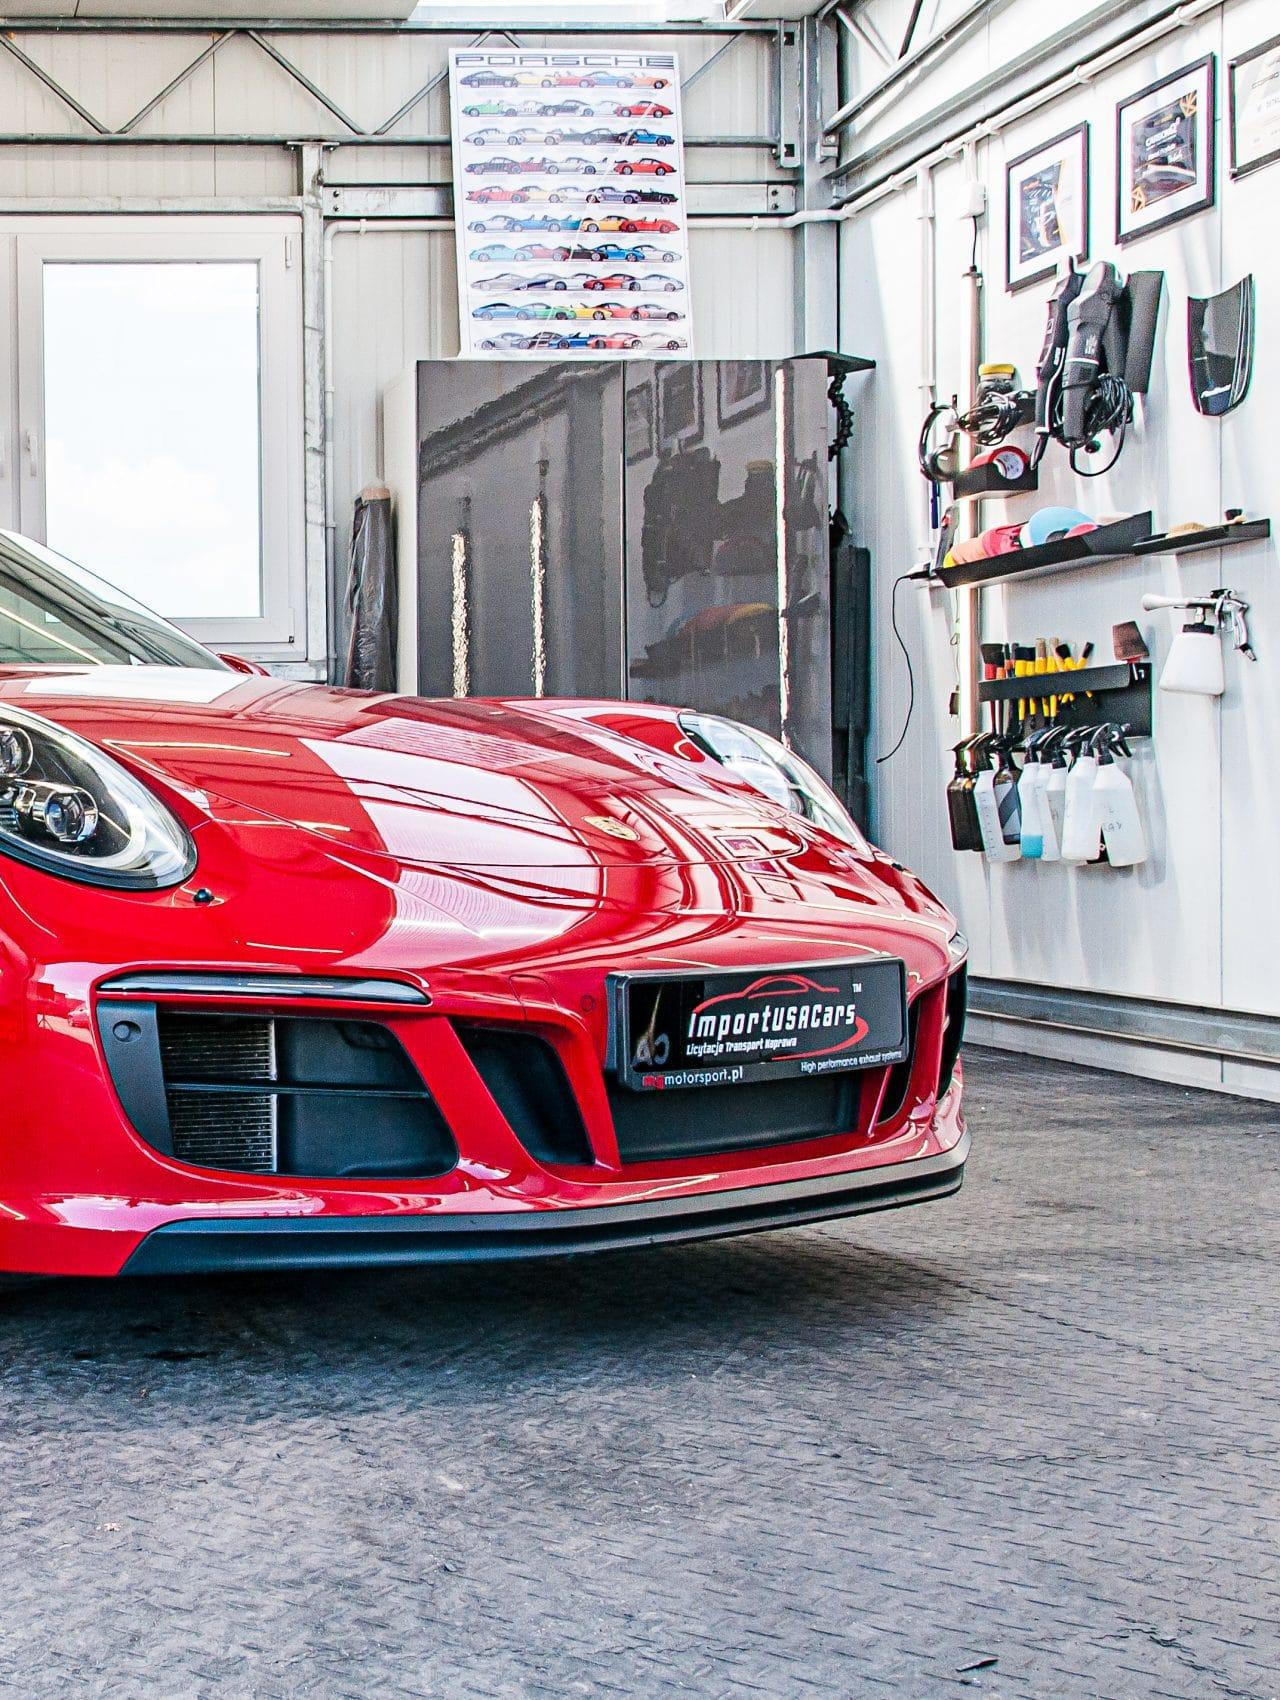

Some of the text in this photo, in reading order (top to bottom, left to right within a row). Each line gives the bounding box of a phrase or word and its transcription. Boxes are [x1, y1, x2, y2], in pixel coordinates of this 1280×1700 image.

[455, 54, 675, 69] PORSCHE
[688, 1003, 856, 1041] ImportUSACars
[686, 1037, 797, 1057] Licytacje Transport Naprawa
[800, 1050, 902, 1073] High performance exhaust systems
